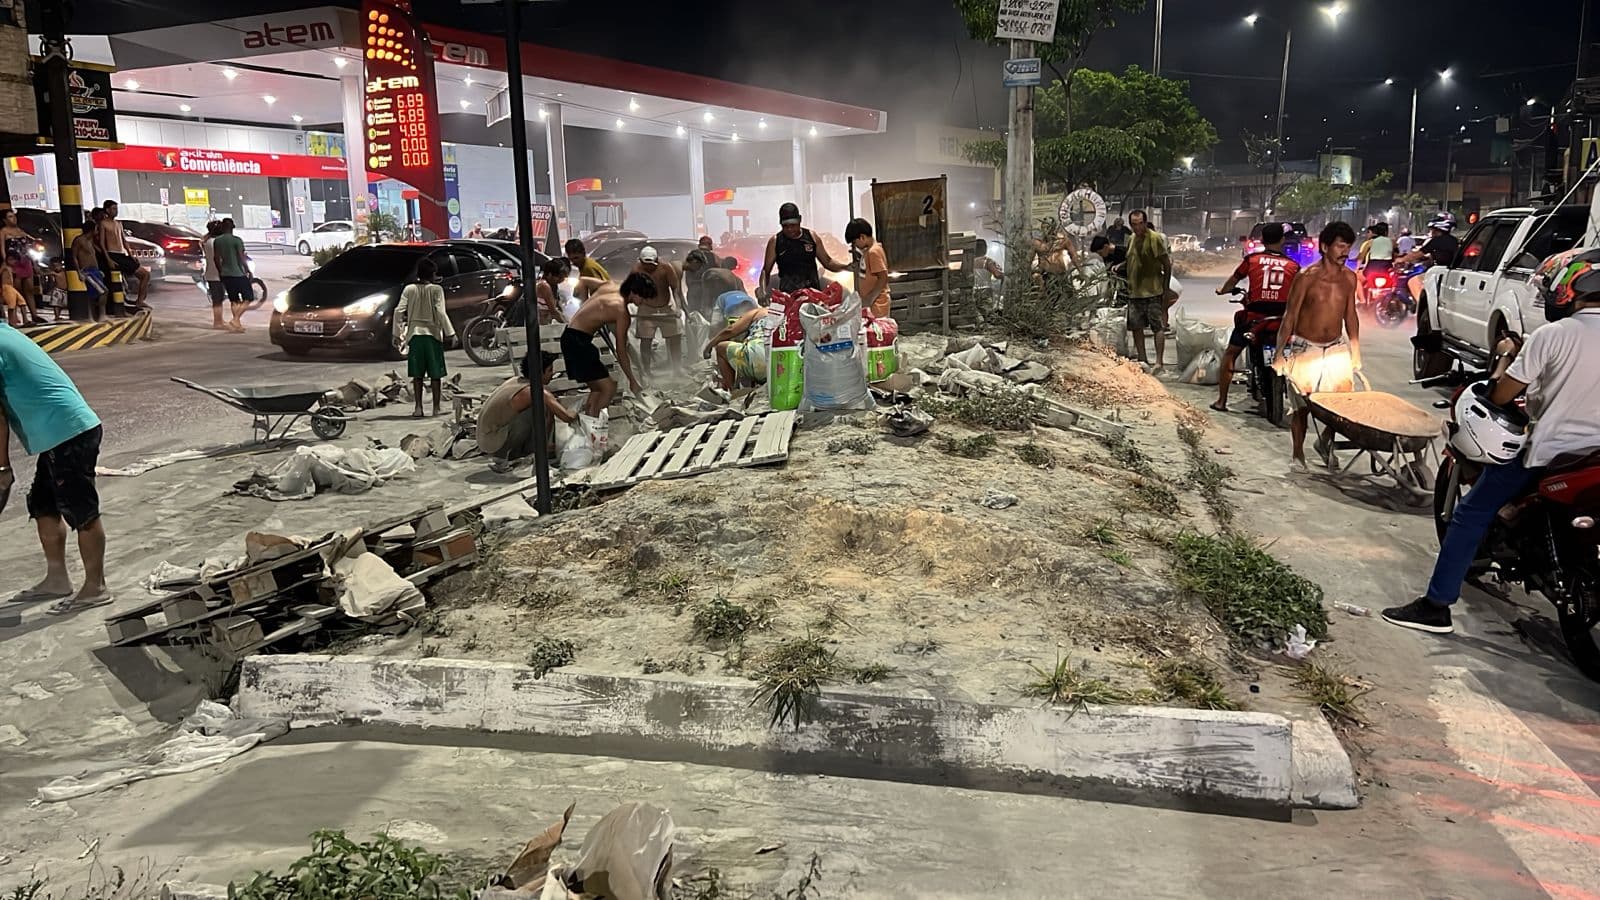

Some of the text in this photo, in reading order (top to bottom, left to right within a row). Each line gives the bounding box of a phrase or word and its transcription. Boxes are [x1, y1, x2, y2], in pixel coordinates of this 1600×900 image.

[244, 22, 335, 48] atem
[366, 76, 420, 93] atem
[180, 156, 261, 174] Conveniência
[922, 195, 935, 215] 2
[1259, 257, 1289, 267] MRV
[1262, 265, 1285, 290] 10
[1261, 290, 1279, 300] DIEGO
